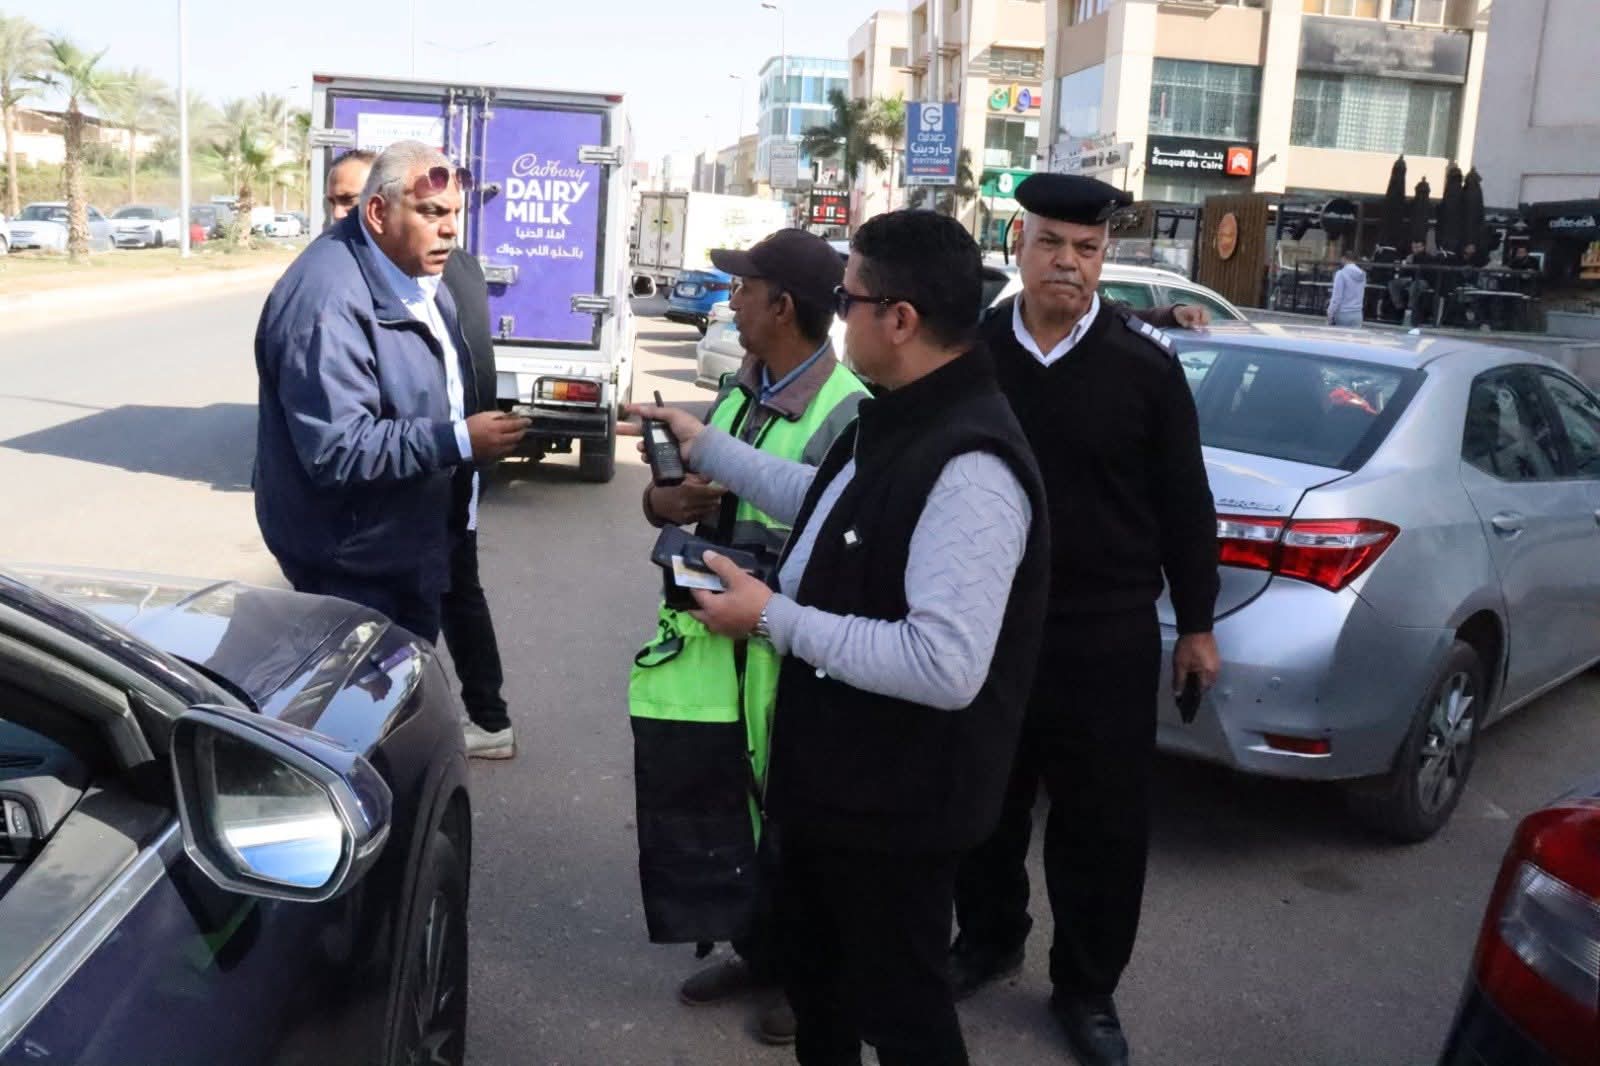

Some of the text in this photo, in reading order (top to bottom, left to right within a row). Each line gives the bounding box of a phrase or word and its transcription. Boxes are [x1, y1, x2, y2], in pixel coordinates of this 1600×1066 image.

[512, 153, 585, 183] Cadbury
[1152, 156, 1224, 170] Banque du Caire
[506, 177, 590, 203] DAIRY
[505, 200, 571, 225] MILK
